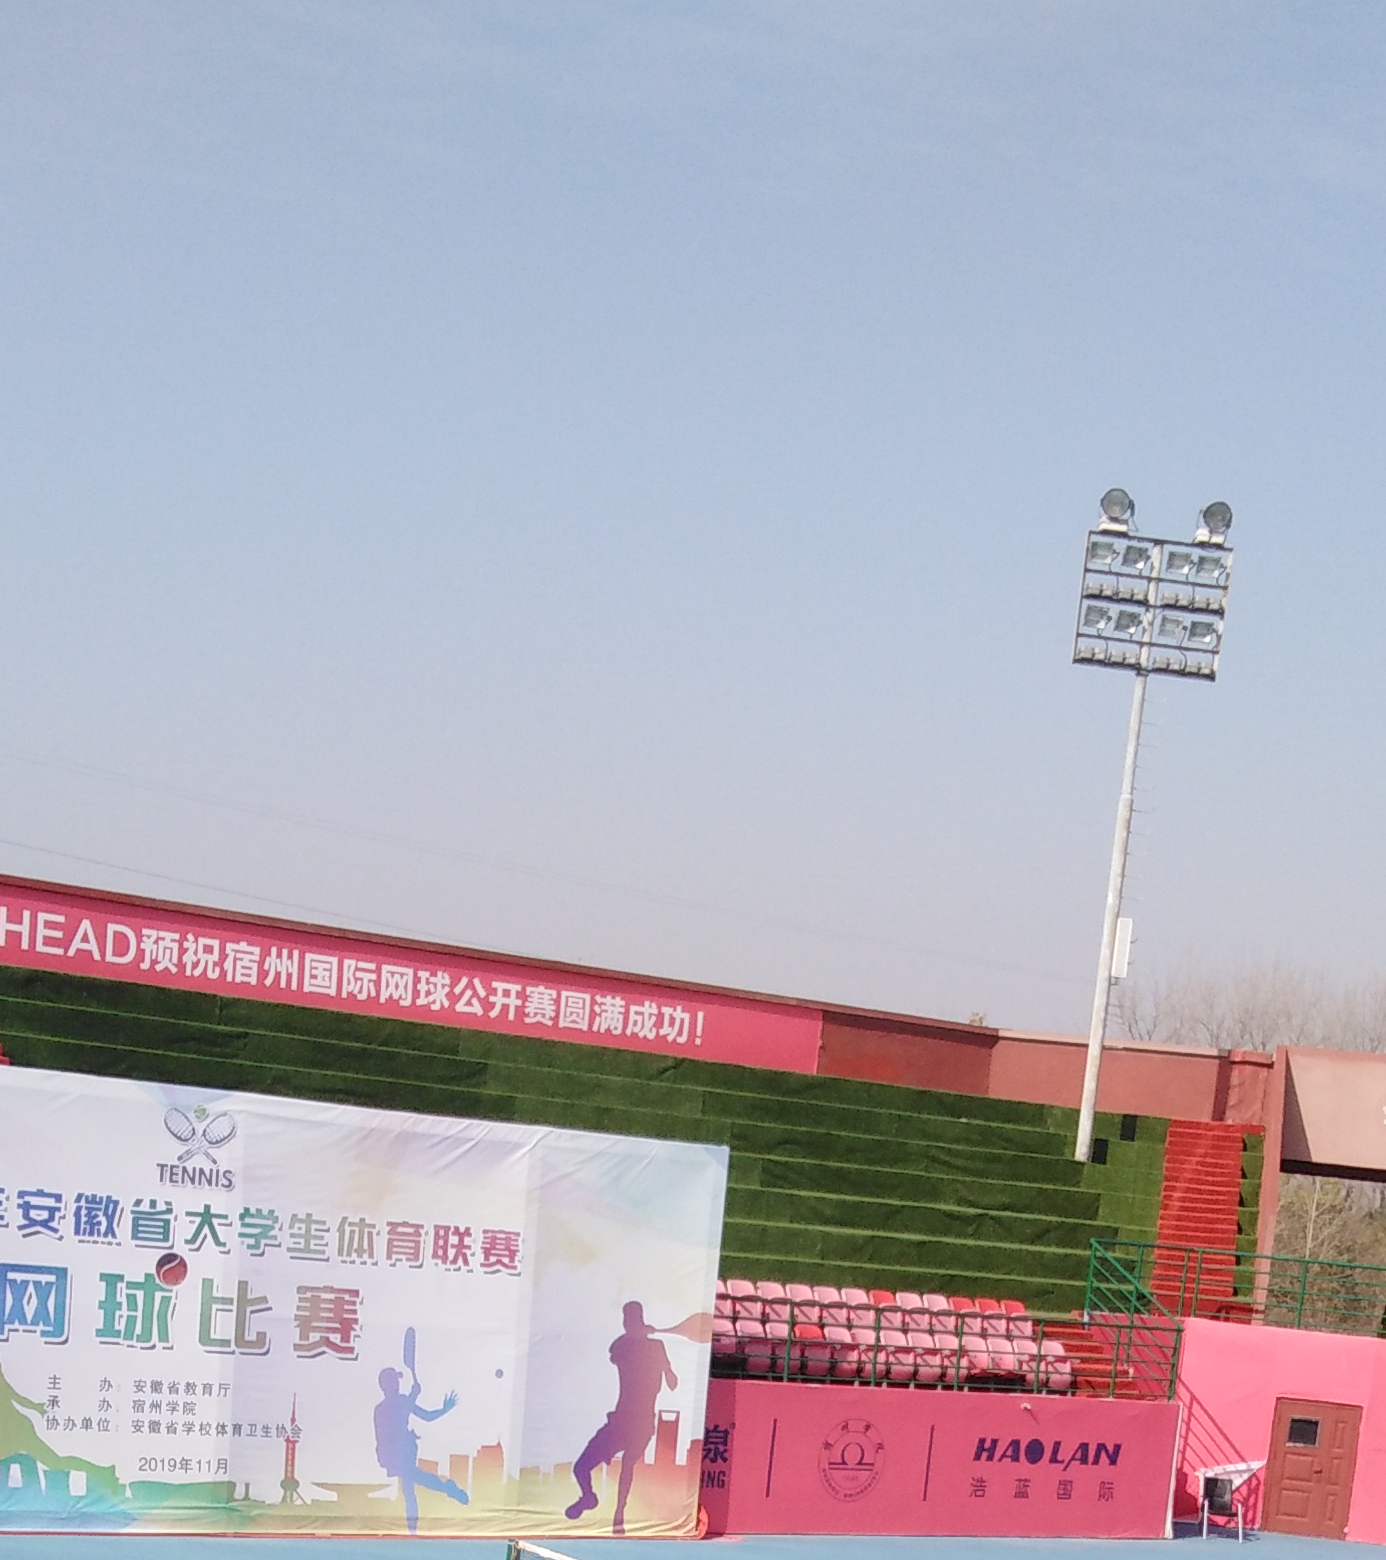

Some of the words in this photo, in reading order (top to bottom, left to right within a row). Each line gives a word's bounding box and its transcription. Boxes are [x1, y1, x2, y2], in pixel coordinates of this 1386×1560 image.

[156, 1163, 233, 1189] TENNIS
[133, 1378, 231, 1398] 安徽省教育厅
[132, 1399, 197, 1417] 宿州学院
[131, 1418, 303, 1440] 安徽省学校体育卫生协会
[972, 1437, 1122, 1472] HAOLAN
[138, 1456, 229, 1476] 2019年11月
